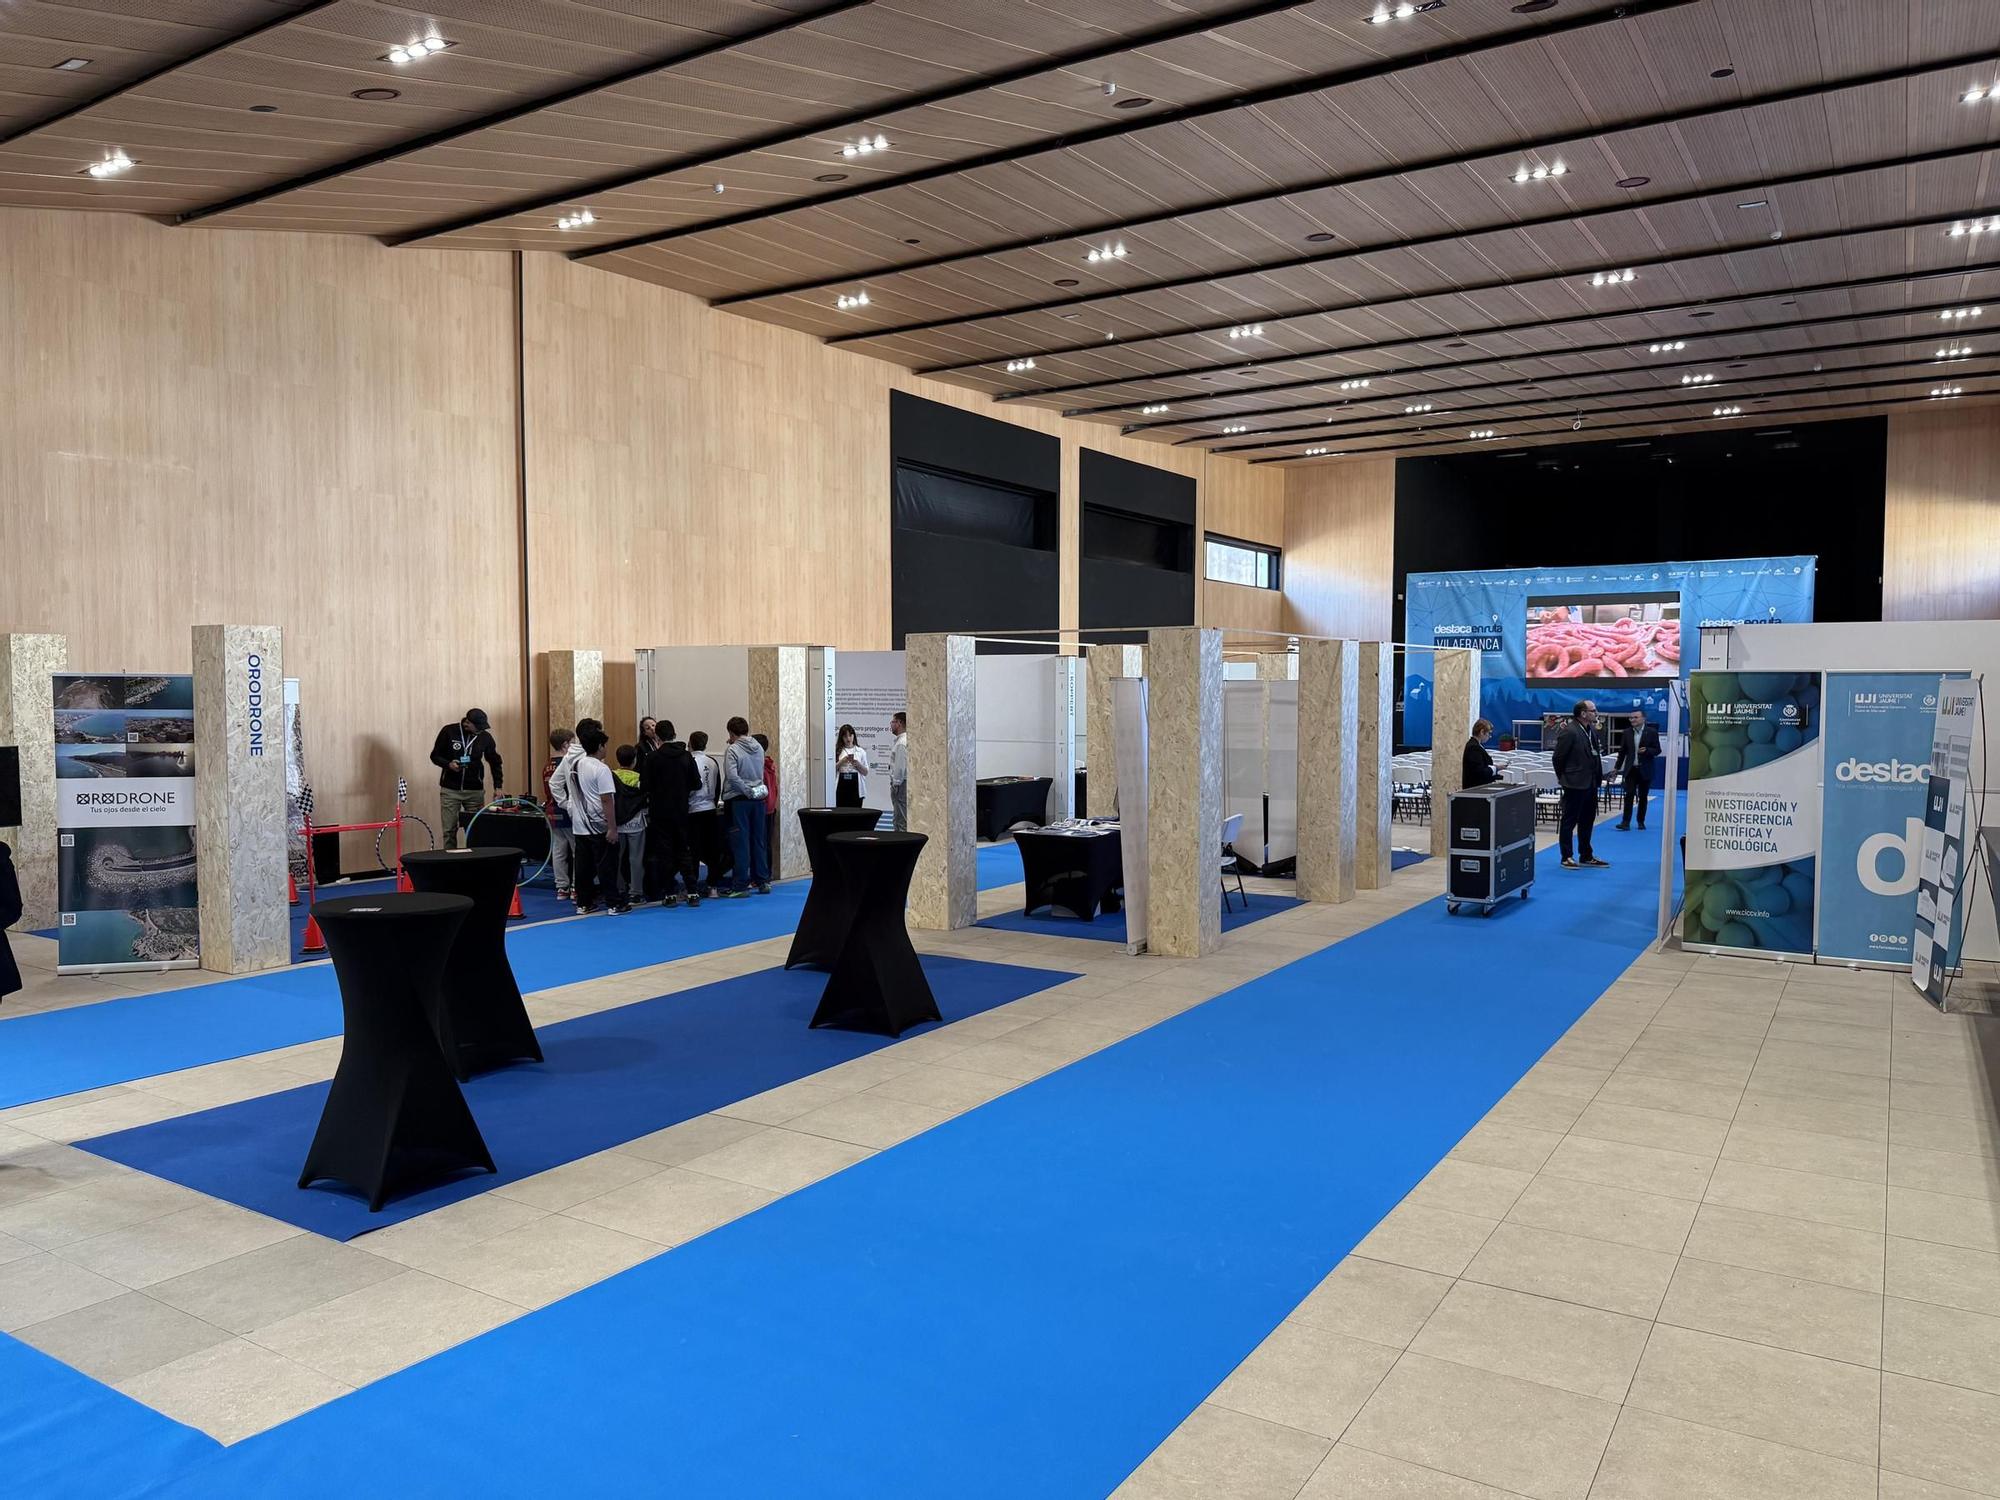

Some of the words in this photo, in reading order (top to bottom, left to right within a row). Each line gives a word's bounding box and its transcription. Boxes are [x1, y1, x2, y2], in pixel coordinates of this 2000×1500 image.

[248, 655, 263, 756] ORODRONE
[1855, 693, 1876, 704] UJI
[1707, 703, 1731, 714] UJI
[1705, 799, 1787, 812] INVESTIGACIÓN
[1791, 802, 1797, 812] Y
[1704, 812, 1793, 826] TRANSFERENCIA
[1704, 824, 1762, 838] CIENTÍFICA
[1766, 828, 1772, 839] Y
[1704, 838, 1778, 852] TECNOLÓGICA
